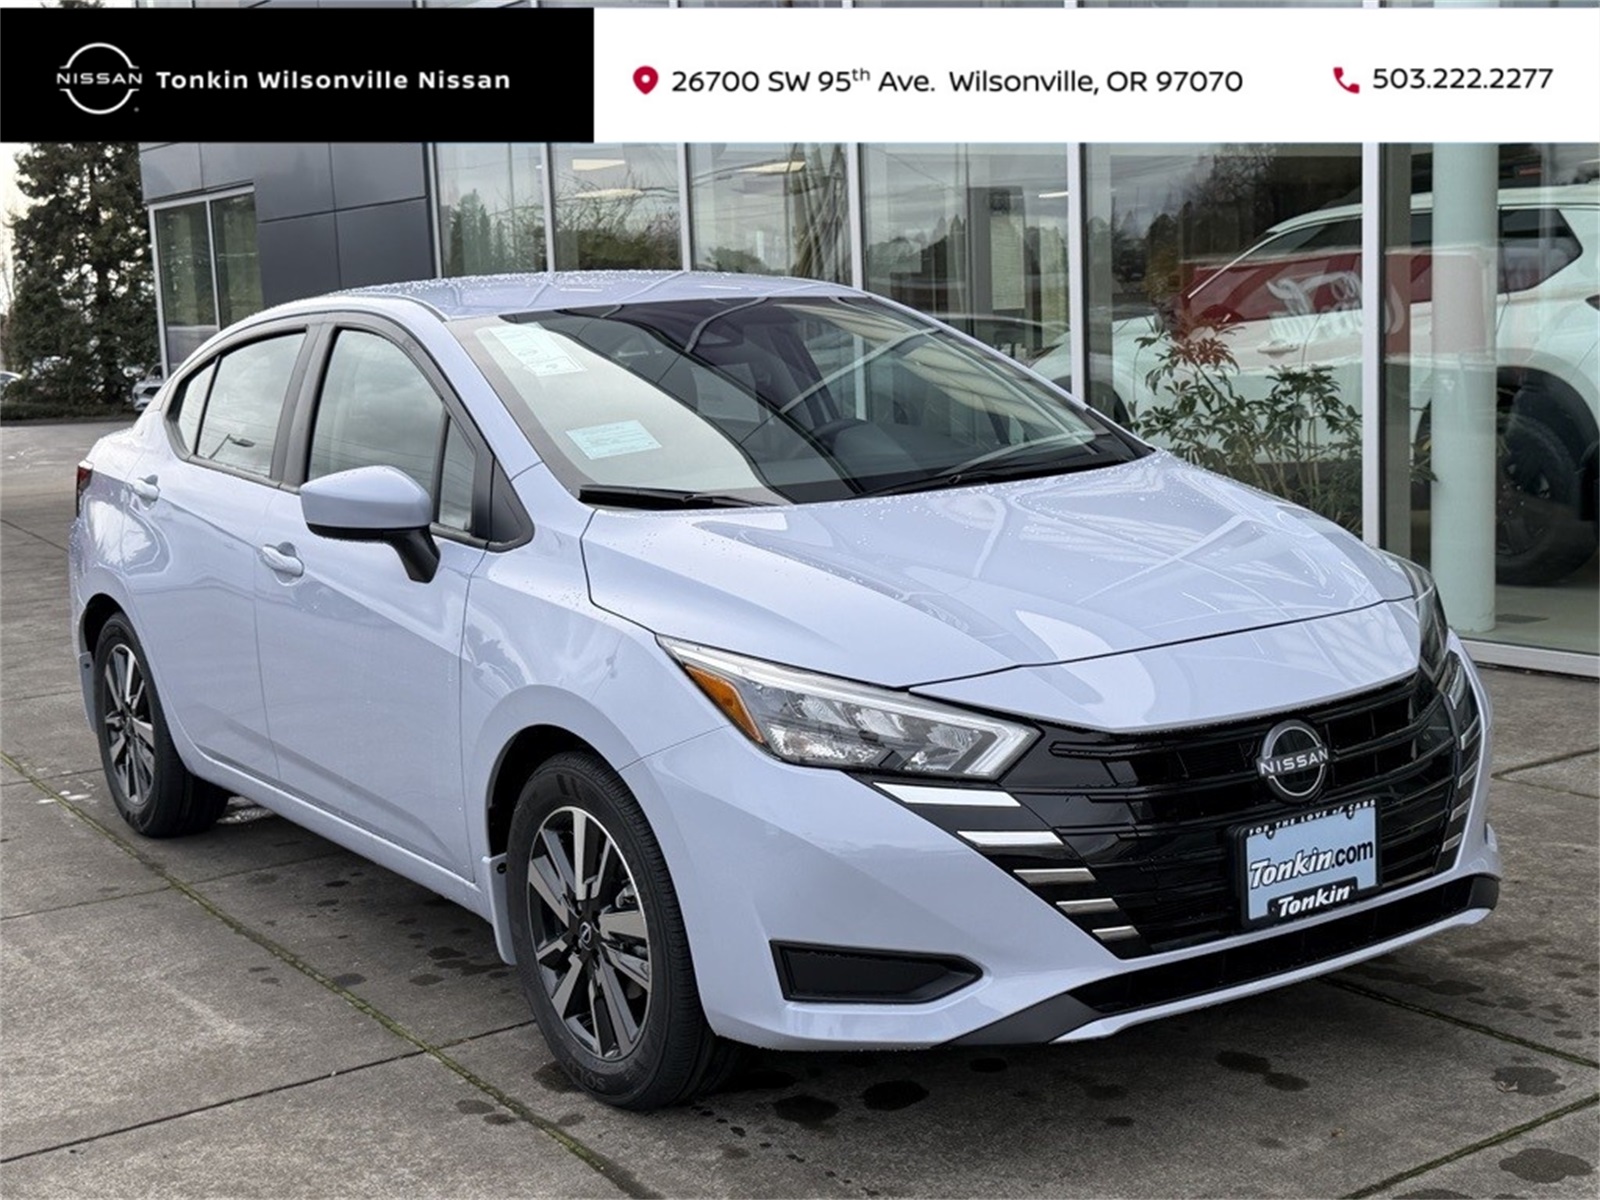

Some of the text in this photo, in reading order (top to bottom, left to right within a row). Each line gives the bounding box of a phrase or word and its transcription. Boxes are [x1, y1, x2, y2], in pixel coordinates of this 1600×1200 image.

[1260, 748, 1329, 775] NISSAN
[1249, 825, 1270, 836] FOR
[1275, 818, 1296, 829] THE
[1300, 810, 1328, 823] LOVE
[1348, 799, 1376, 811] CARS
[1249, 841, 1374, 890] Tonkin.com
[1278, 885, 1351, 917] Tonkin
